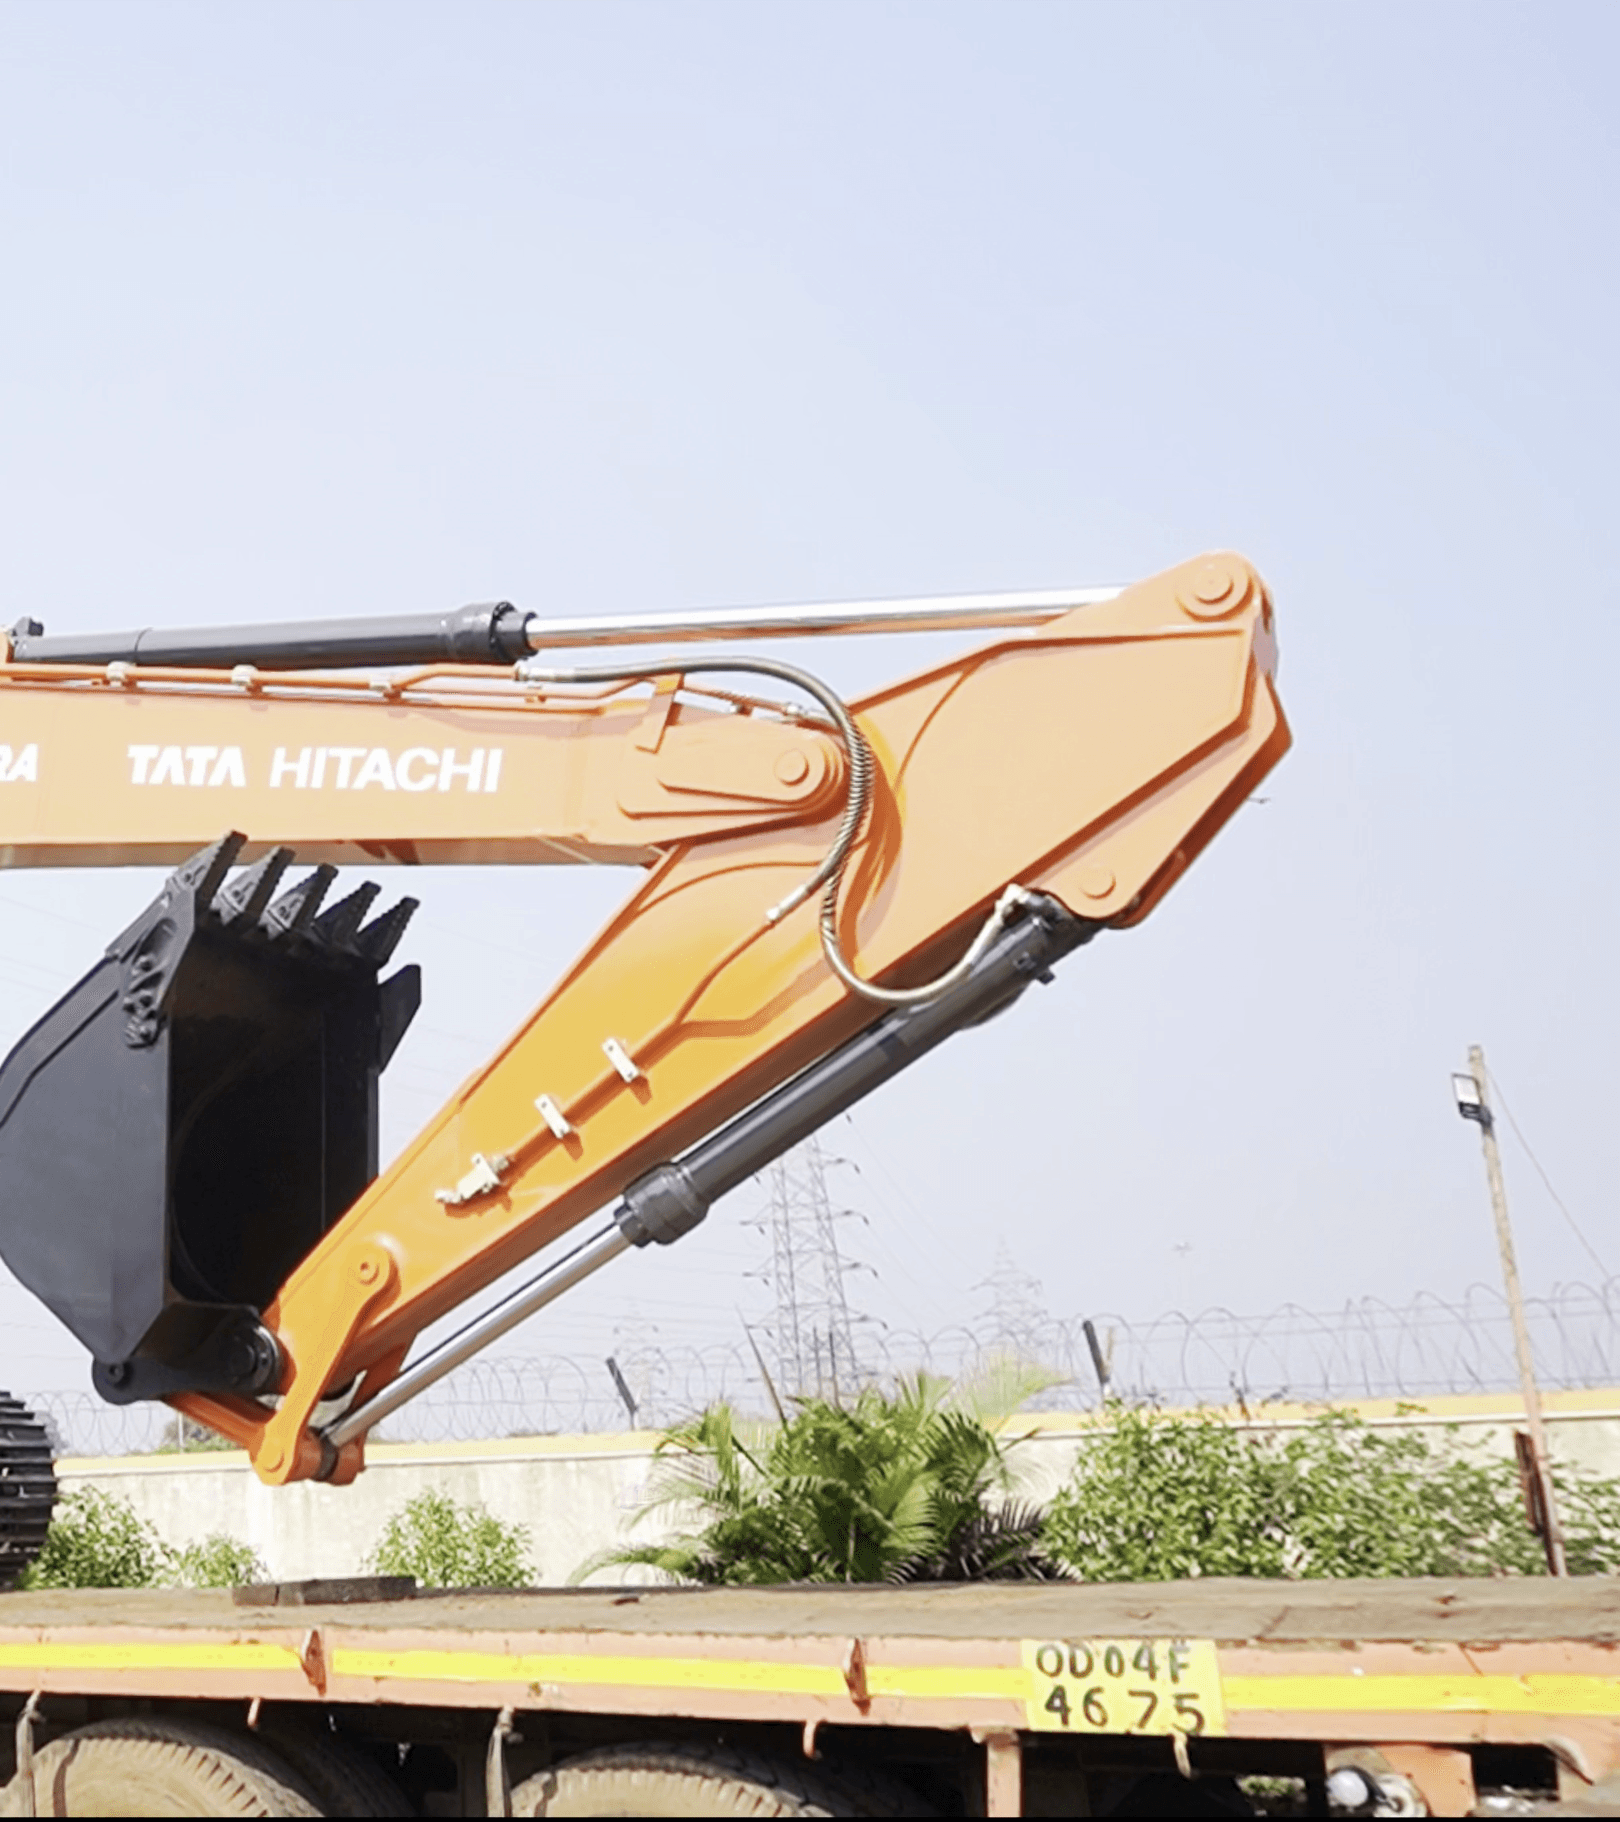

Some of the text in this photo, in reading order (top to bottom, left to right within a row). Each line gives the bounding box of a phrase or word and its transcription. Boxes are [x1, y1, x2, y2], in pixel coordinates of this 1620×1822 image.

[127, 744, 503, 793] TATA HITACHI
[1044, 1684, 1206, 1736] 4675
